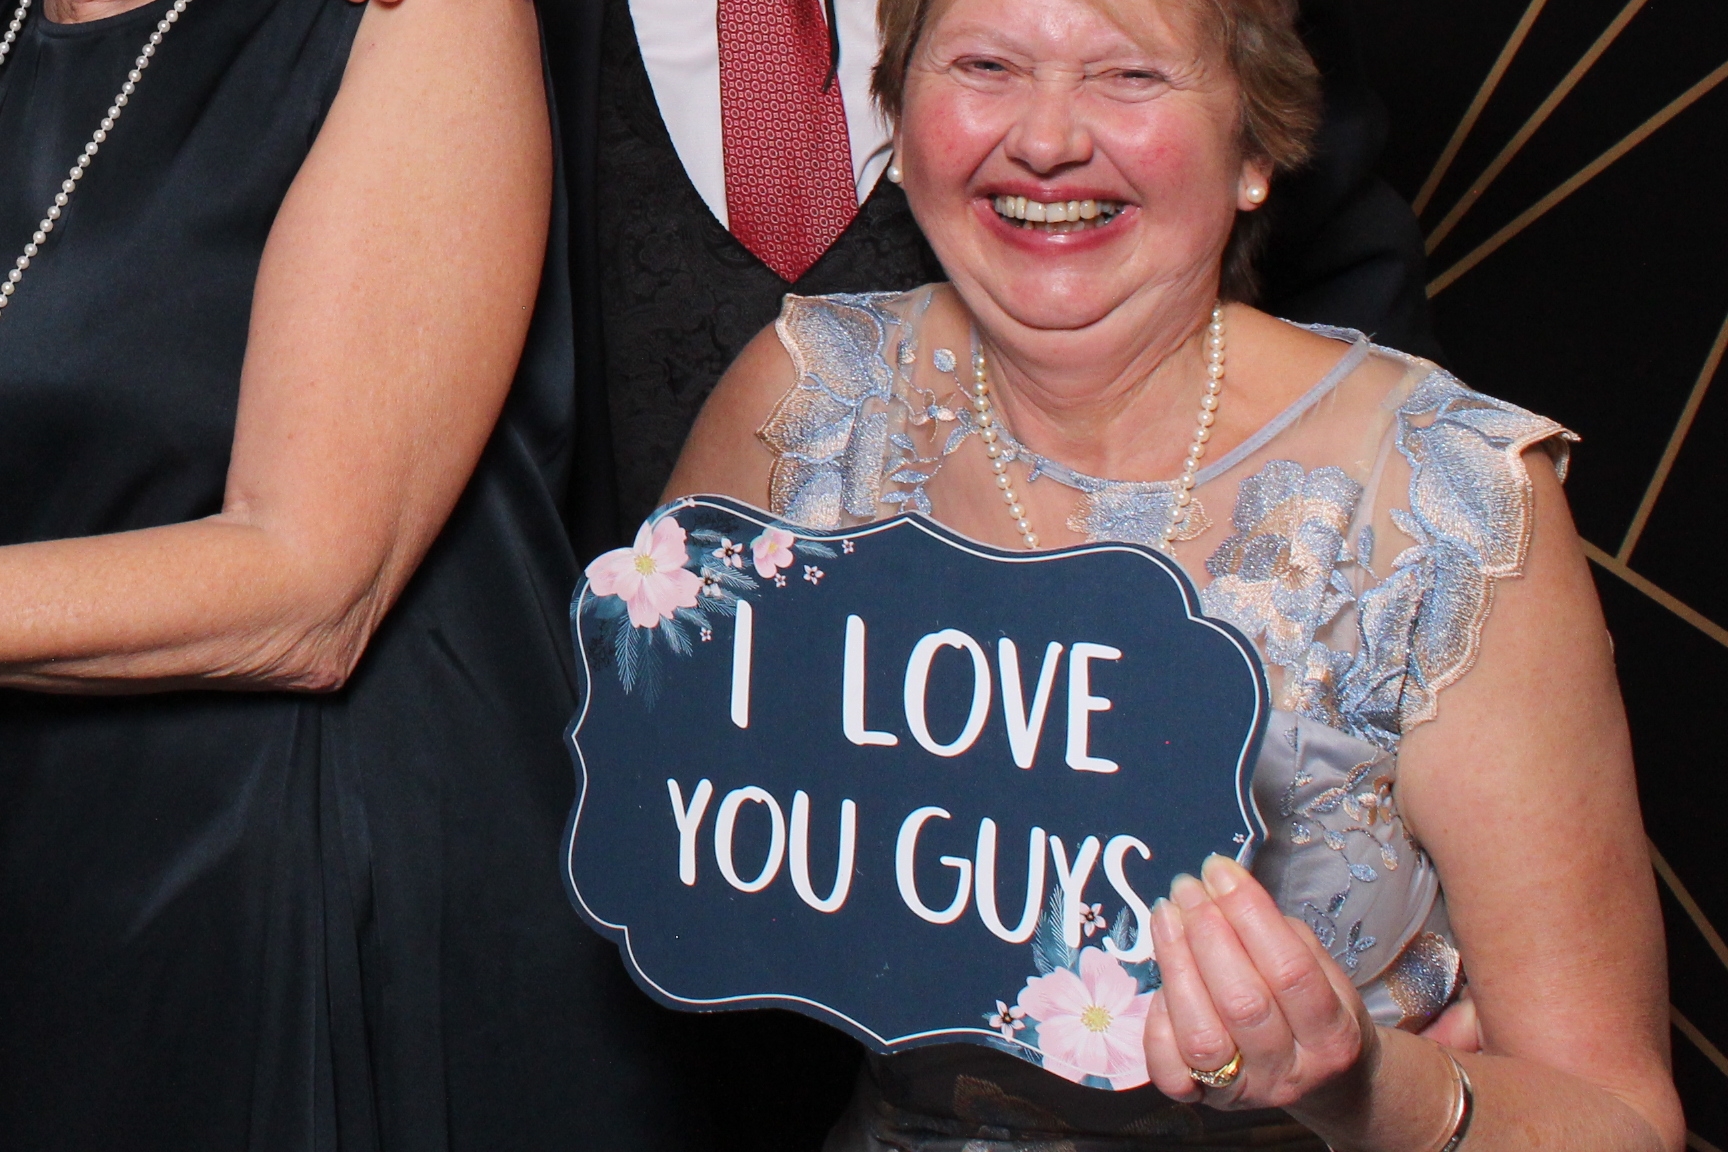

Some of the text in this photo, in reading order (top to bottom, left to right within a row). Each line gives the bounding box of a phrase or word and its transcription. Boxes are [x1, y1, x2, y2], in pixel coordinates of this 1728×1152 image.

[730, 599, 1123, 774] I LOVE
[666, 778, 1156, 964] YOU GUYS
